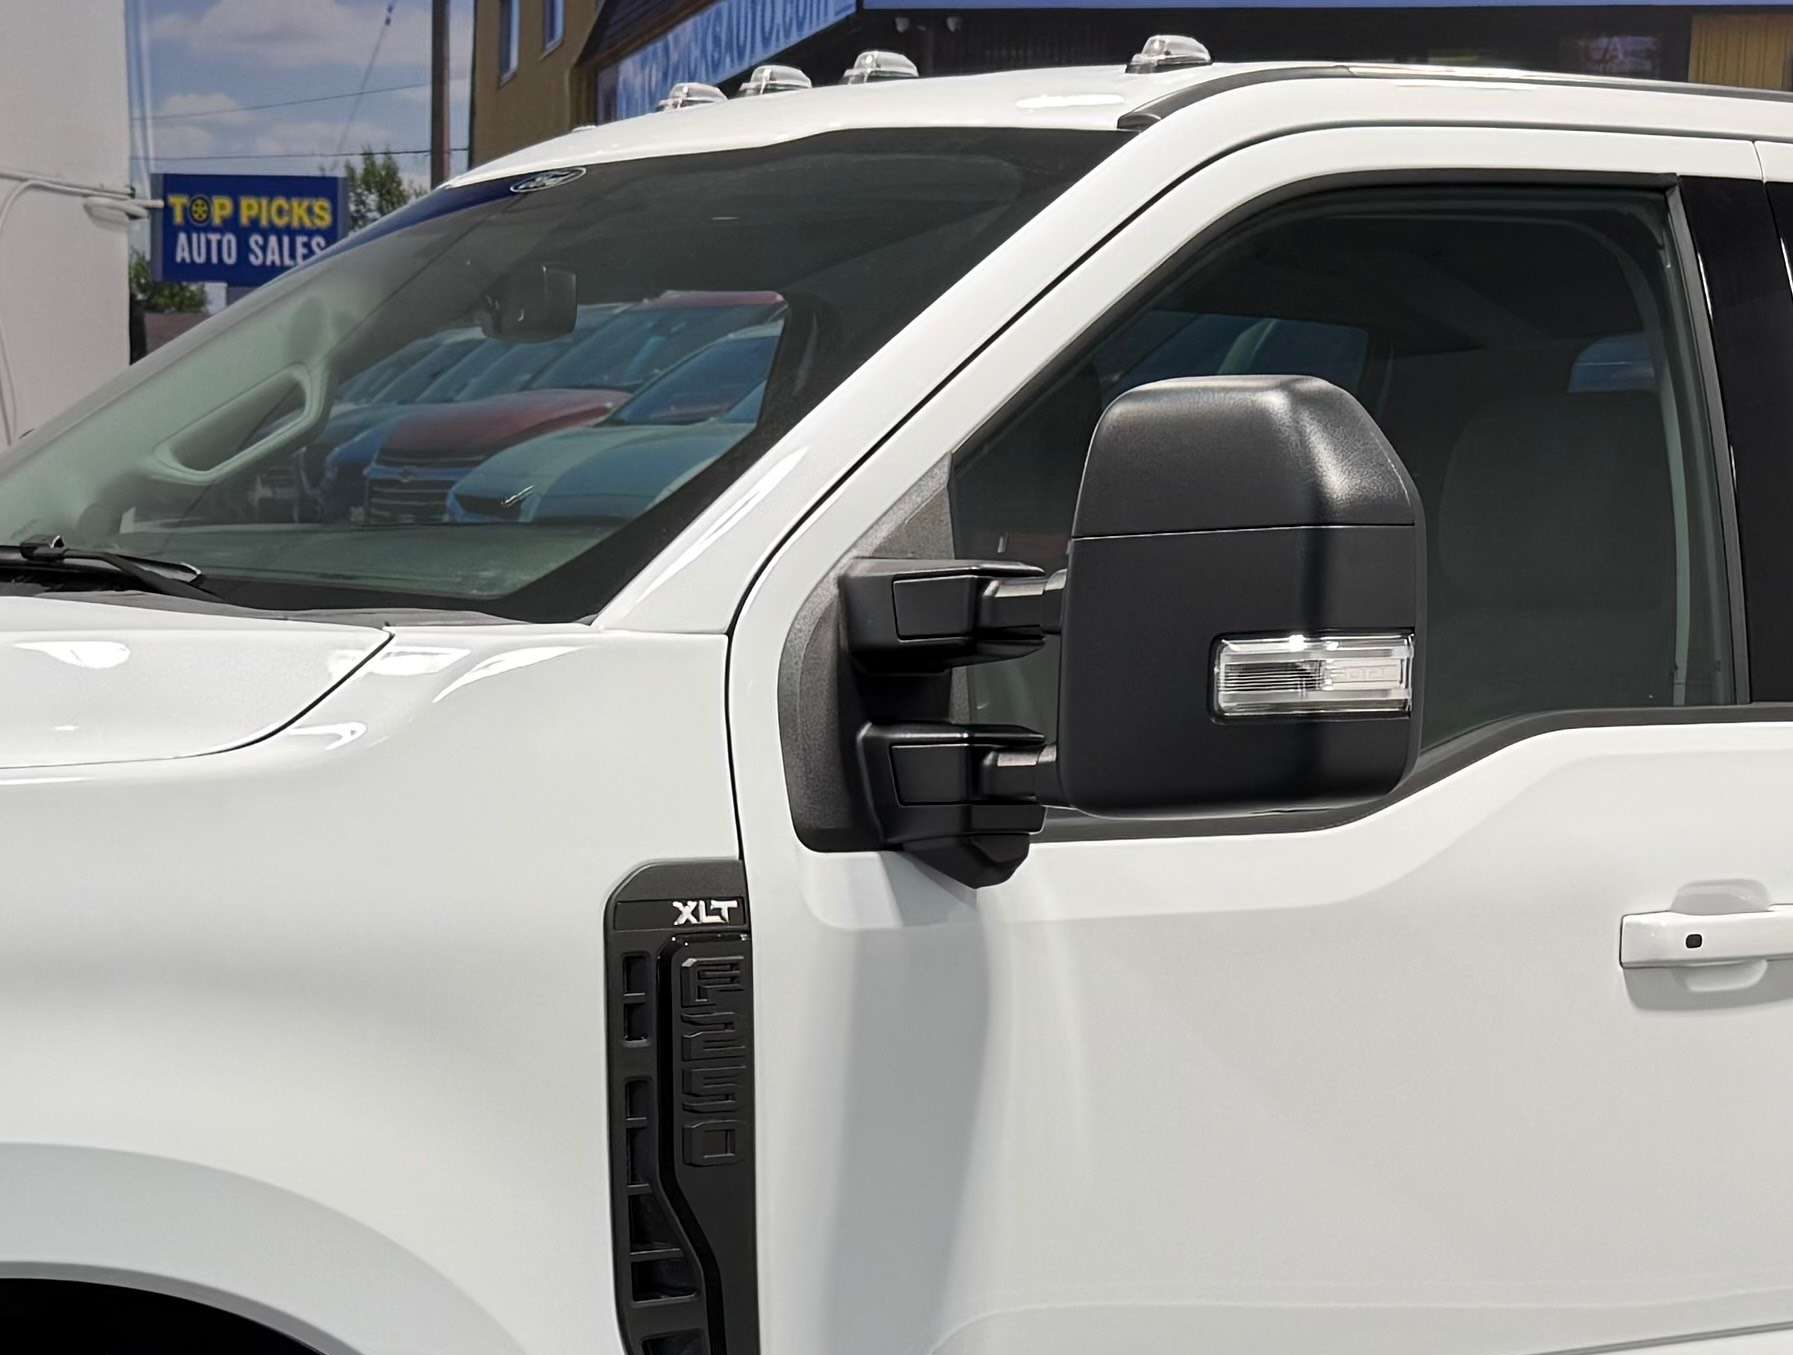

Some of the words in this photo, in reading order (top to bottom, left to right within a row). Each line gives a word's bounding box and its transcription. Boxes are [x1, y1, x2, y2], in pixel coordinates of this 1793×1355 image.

[167, 193, 236, 227] TOP
[239, 196, 332, 229] PICKS
[175, 231, 238, 266] AUTO
[672, 898, 739, 926] XLT
